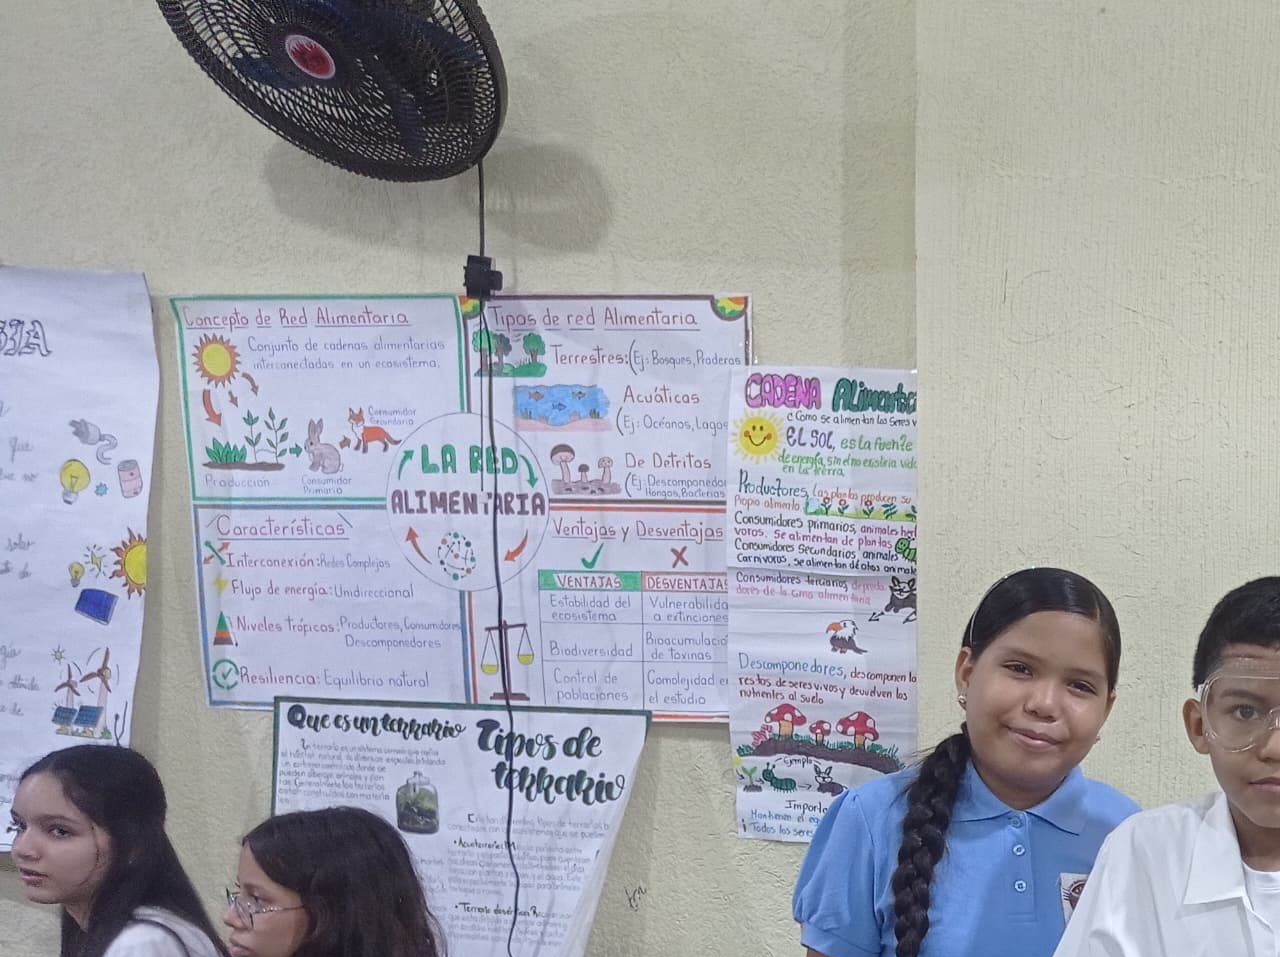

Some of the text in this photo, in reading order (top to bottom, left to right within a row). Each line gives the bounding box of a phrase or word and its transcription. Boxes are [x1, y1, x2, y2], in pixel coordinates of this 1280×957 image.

[183, 305, 409, 332] Concepto de Red Alimentaria
[488, 306, 698, 332] Tipos de red Alimentaria
[0, 319, 52, 357] IA
[248, 336, 445, 357] Conjunto de cadenas alimentarias
[253, 356, 334, 369] interconectadas
[341, 360, 353, 369] en
[360, 360, 371, 369] un
[623, 385, 700, 404] Acuáticas
[745, 373, 822, 410] CADENA
[821, 415, 831, 424] se
[421, 444, 519, 475] LA RED
[625, 452, 711, 469] De Detritos
[205, 474, 270, 488] Producción
[391, 489, 546, 516] ALIMENTARIA
[217, 515, 345, 536] Características
[735, 511, 803, 529] Consumidores
[553, 517, 723, 544] Ventajas y Desventajas
[735, 538, 795, 553] Consumidores
[841, 534, 853, 546] de
[557, 575, 728, 590] VENTAJAS DESVENTAJAS
[736, 572, 801, 584] Consumidores
[232, 579, 262, 600] Flujo
[267, 580, 280, 595] de
[334, 583, 414, 598] Unidireccional
[550, 594, 630, 608] Estabilidad del
[650, 596, 728, 609] Vulnerabilida
[237, 616, 282, 631] Niveles
[552, 610, 616, 622] ecosistema
[654, 614, 661, 622] a
[345, 634, 441, 651] Descomponedores
[646, 632, 728, 646] Bioacumulació
[550, 640, 633, 657] Biodiversidad
[651, 647, 712, 660] de toxinas
[324, 669, 383, 690] Equilibrio
[389, 671, 429, 688] natural
[554, 668, 617, 684] Control de
[557, 687, 628, 703] poblaciones
[649, 692, 706, 704] el estudio
[287, 704, 466, 741] Que es un terrario
[476, 719, 559, 761] Tipos
[562, 726, 602, 759] de
[491, 761, 625, 805] terrario
